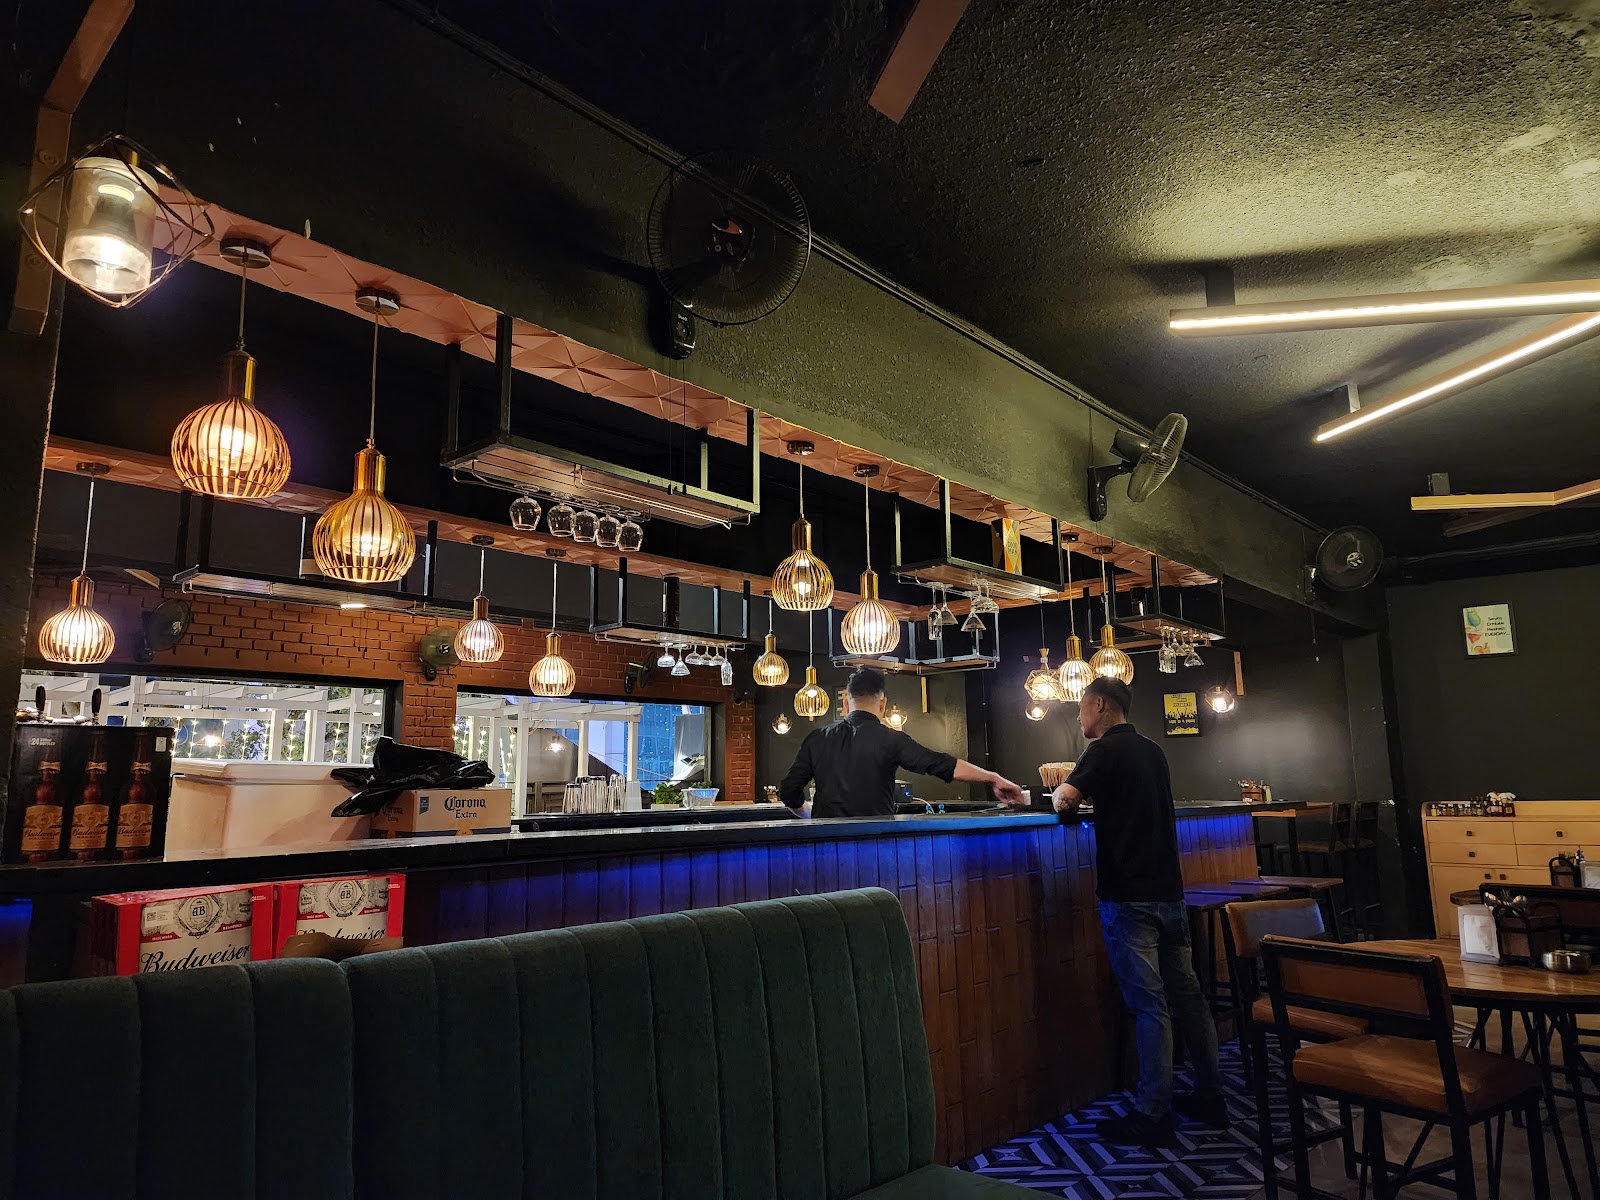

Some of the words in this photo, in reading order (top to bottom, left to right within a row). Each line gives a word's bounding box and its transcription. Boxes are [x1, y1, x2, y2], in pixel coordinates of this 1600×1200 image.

[444, 796, 487, 812] Corona
[456, 811, 477, 819] Extra
[141, 944, 250, 973] Budweiser
